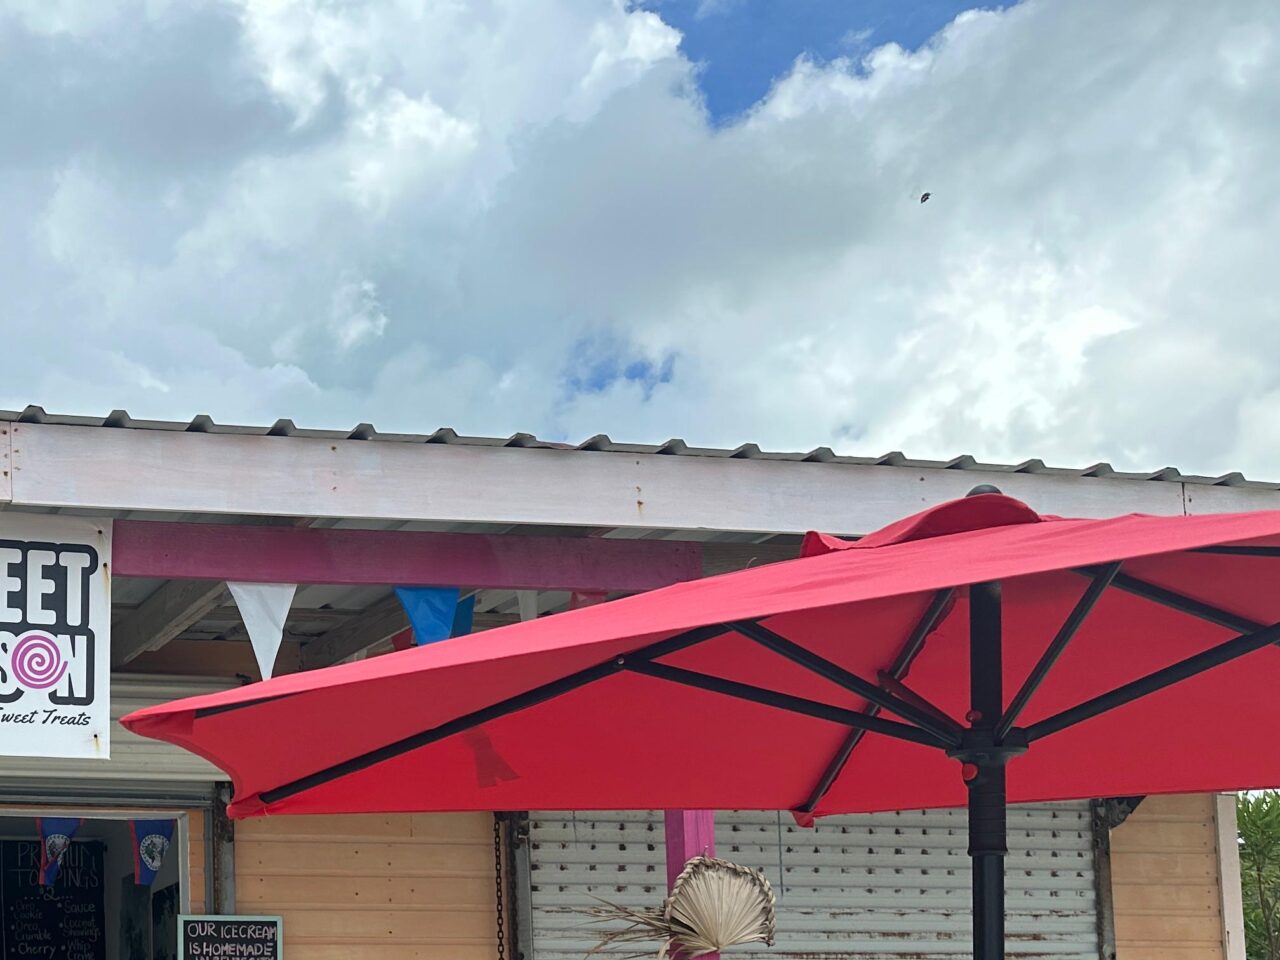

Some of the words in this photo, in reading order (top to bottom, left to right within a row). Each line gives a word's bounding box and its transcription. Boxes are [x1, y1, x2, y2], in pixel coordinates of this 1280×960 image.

[41, 708, 92, 727] Treats
[187, 922, 218, 938] OUR
[17, 943, 57, 960] Cherry
[189, 941, 201, 955] IS
[203, 941, 274, 957] HOMEMADE
